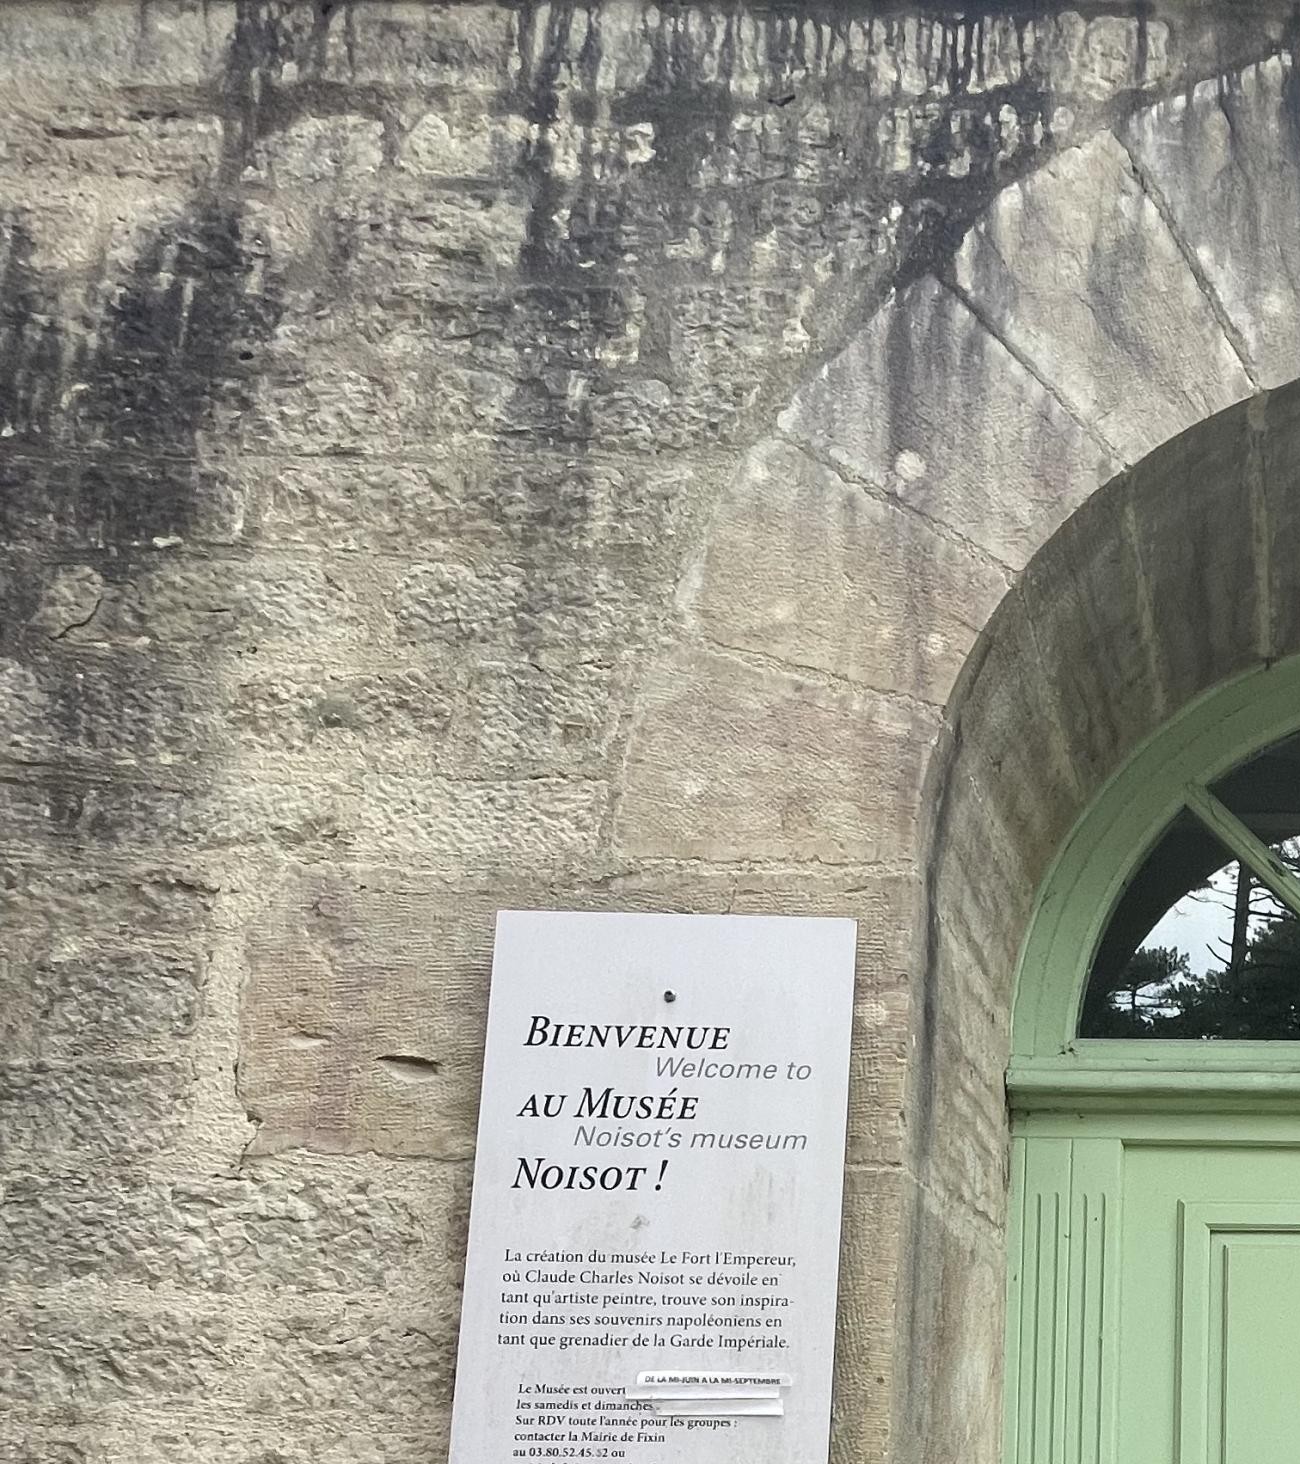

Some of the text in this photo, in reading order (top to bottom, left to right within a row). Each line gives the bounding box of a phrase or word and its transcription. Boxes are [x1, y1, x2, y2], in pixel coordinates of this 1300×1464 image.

[523, 1016, 731, 1050] BIENVENUE
[656, 1057, 811, 1081] Welcome to
[517, 1088, 699, 1120] AU MUSÉE
[574, 1126, 807, 1150] Noisot's museum
[511, 1158, 669, 1191] NOISOT !
[505, 1249, 796, 1269] La création du musée Le Fort l'Empereur,
[503, 1270, 778, 1286] où Claude Charles Noisot se dévoile en
[501, 1291, 794, 1310] tant qu'artiste peintre, trouve son inspira-
[499, 1311, 782, 1331] tion dans ses souvenirs napoléoniens en
[498, 1333, 789, 1352] tant que grenadier de la Garde Impériale.
[518, 1384, 626, 1395] Le Musée est ouvert
[517, 1401, 653, 1411] les samedis et dimanches
[516, 1417, 534, 1425] Sur
[538, 1417, 566, 1426] RDV
[569, 1418, 596, 1426] toute
[599, 1417, 637, 1426] l'année
[641, 1419, 667, 1429] pour
[670, 1418, 684, 1427] les
[687, 1419, 731, 1430] groupes
[514, 1431, 665, 1442] contacter la Mairie de Fixin
